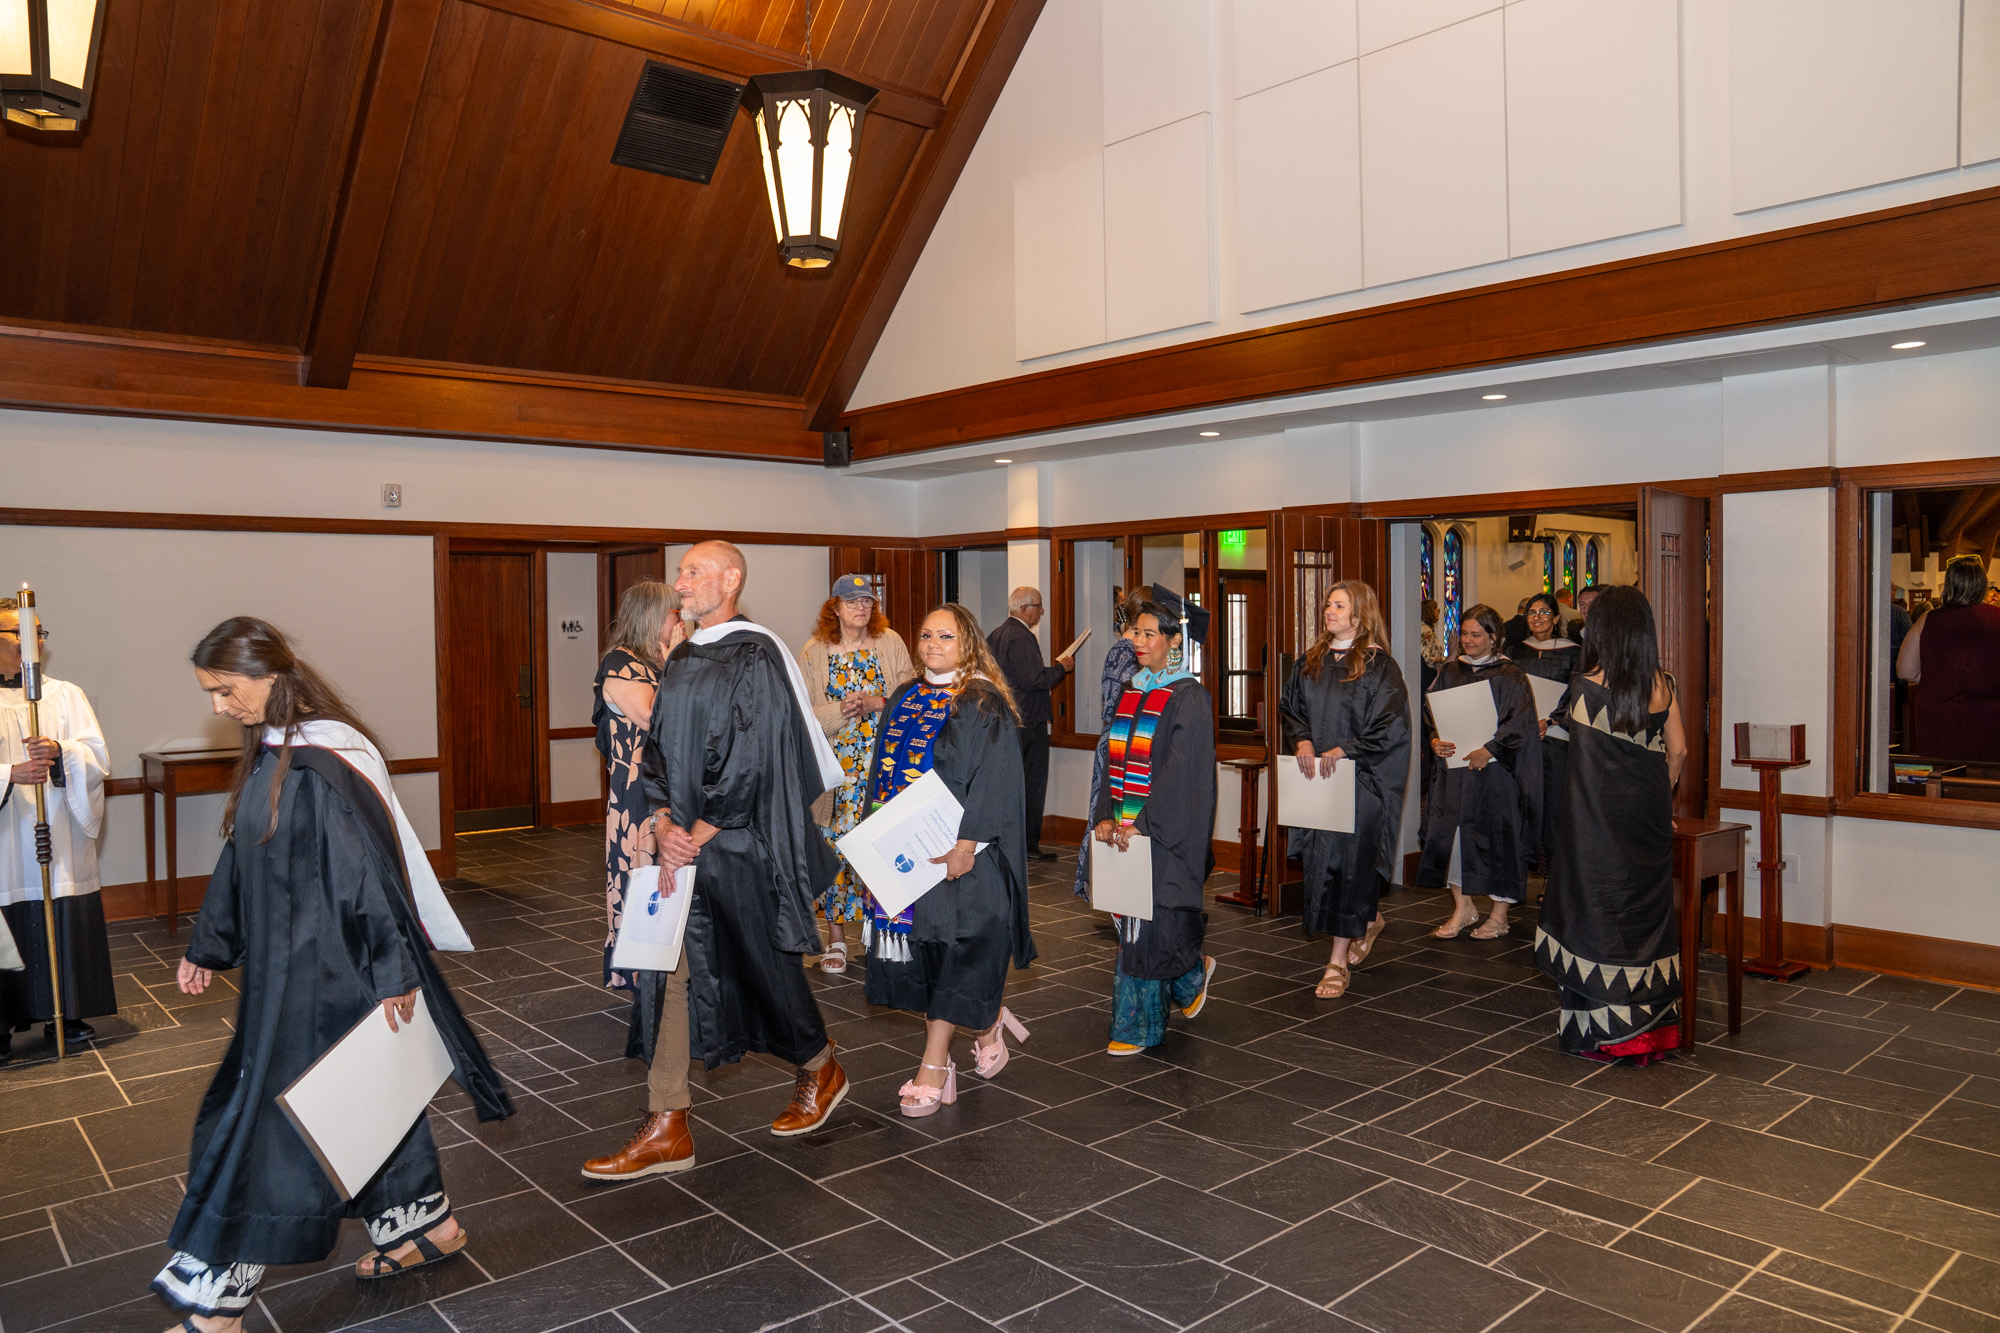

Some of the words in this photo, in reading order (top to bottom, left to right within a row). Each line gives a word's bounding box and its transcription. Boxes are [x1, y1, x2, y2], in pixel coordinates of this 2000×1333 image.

[902, 702, 923, 711] CLASS
[924, 711, 946, 719] CLASS
[886, 728, 904, 737] 2025
[909, 739, 928, 747] 2025
